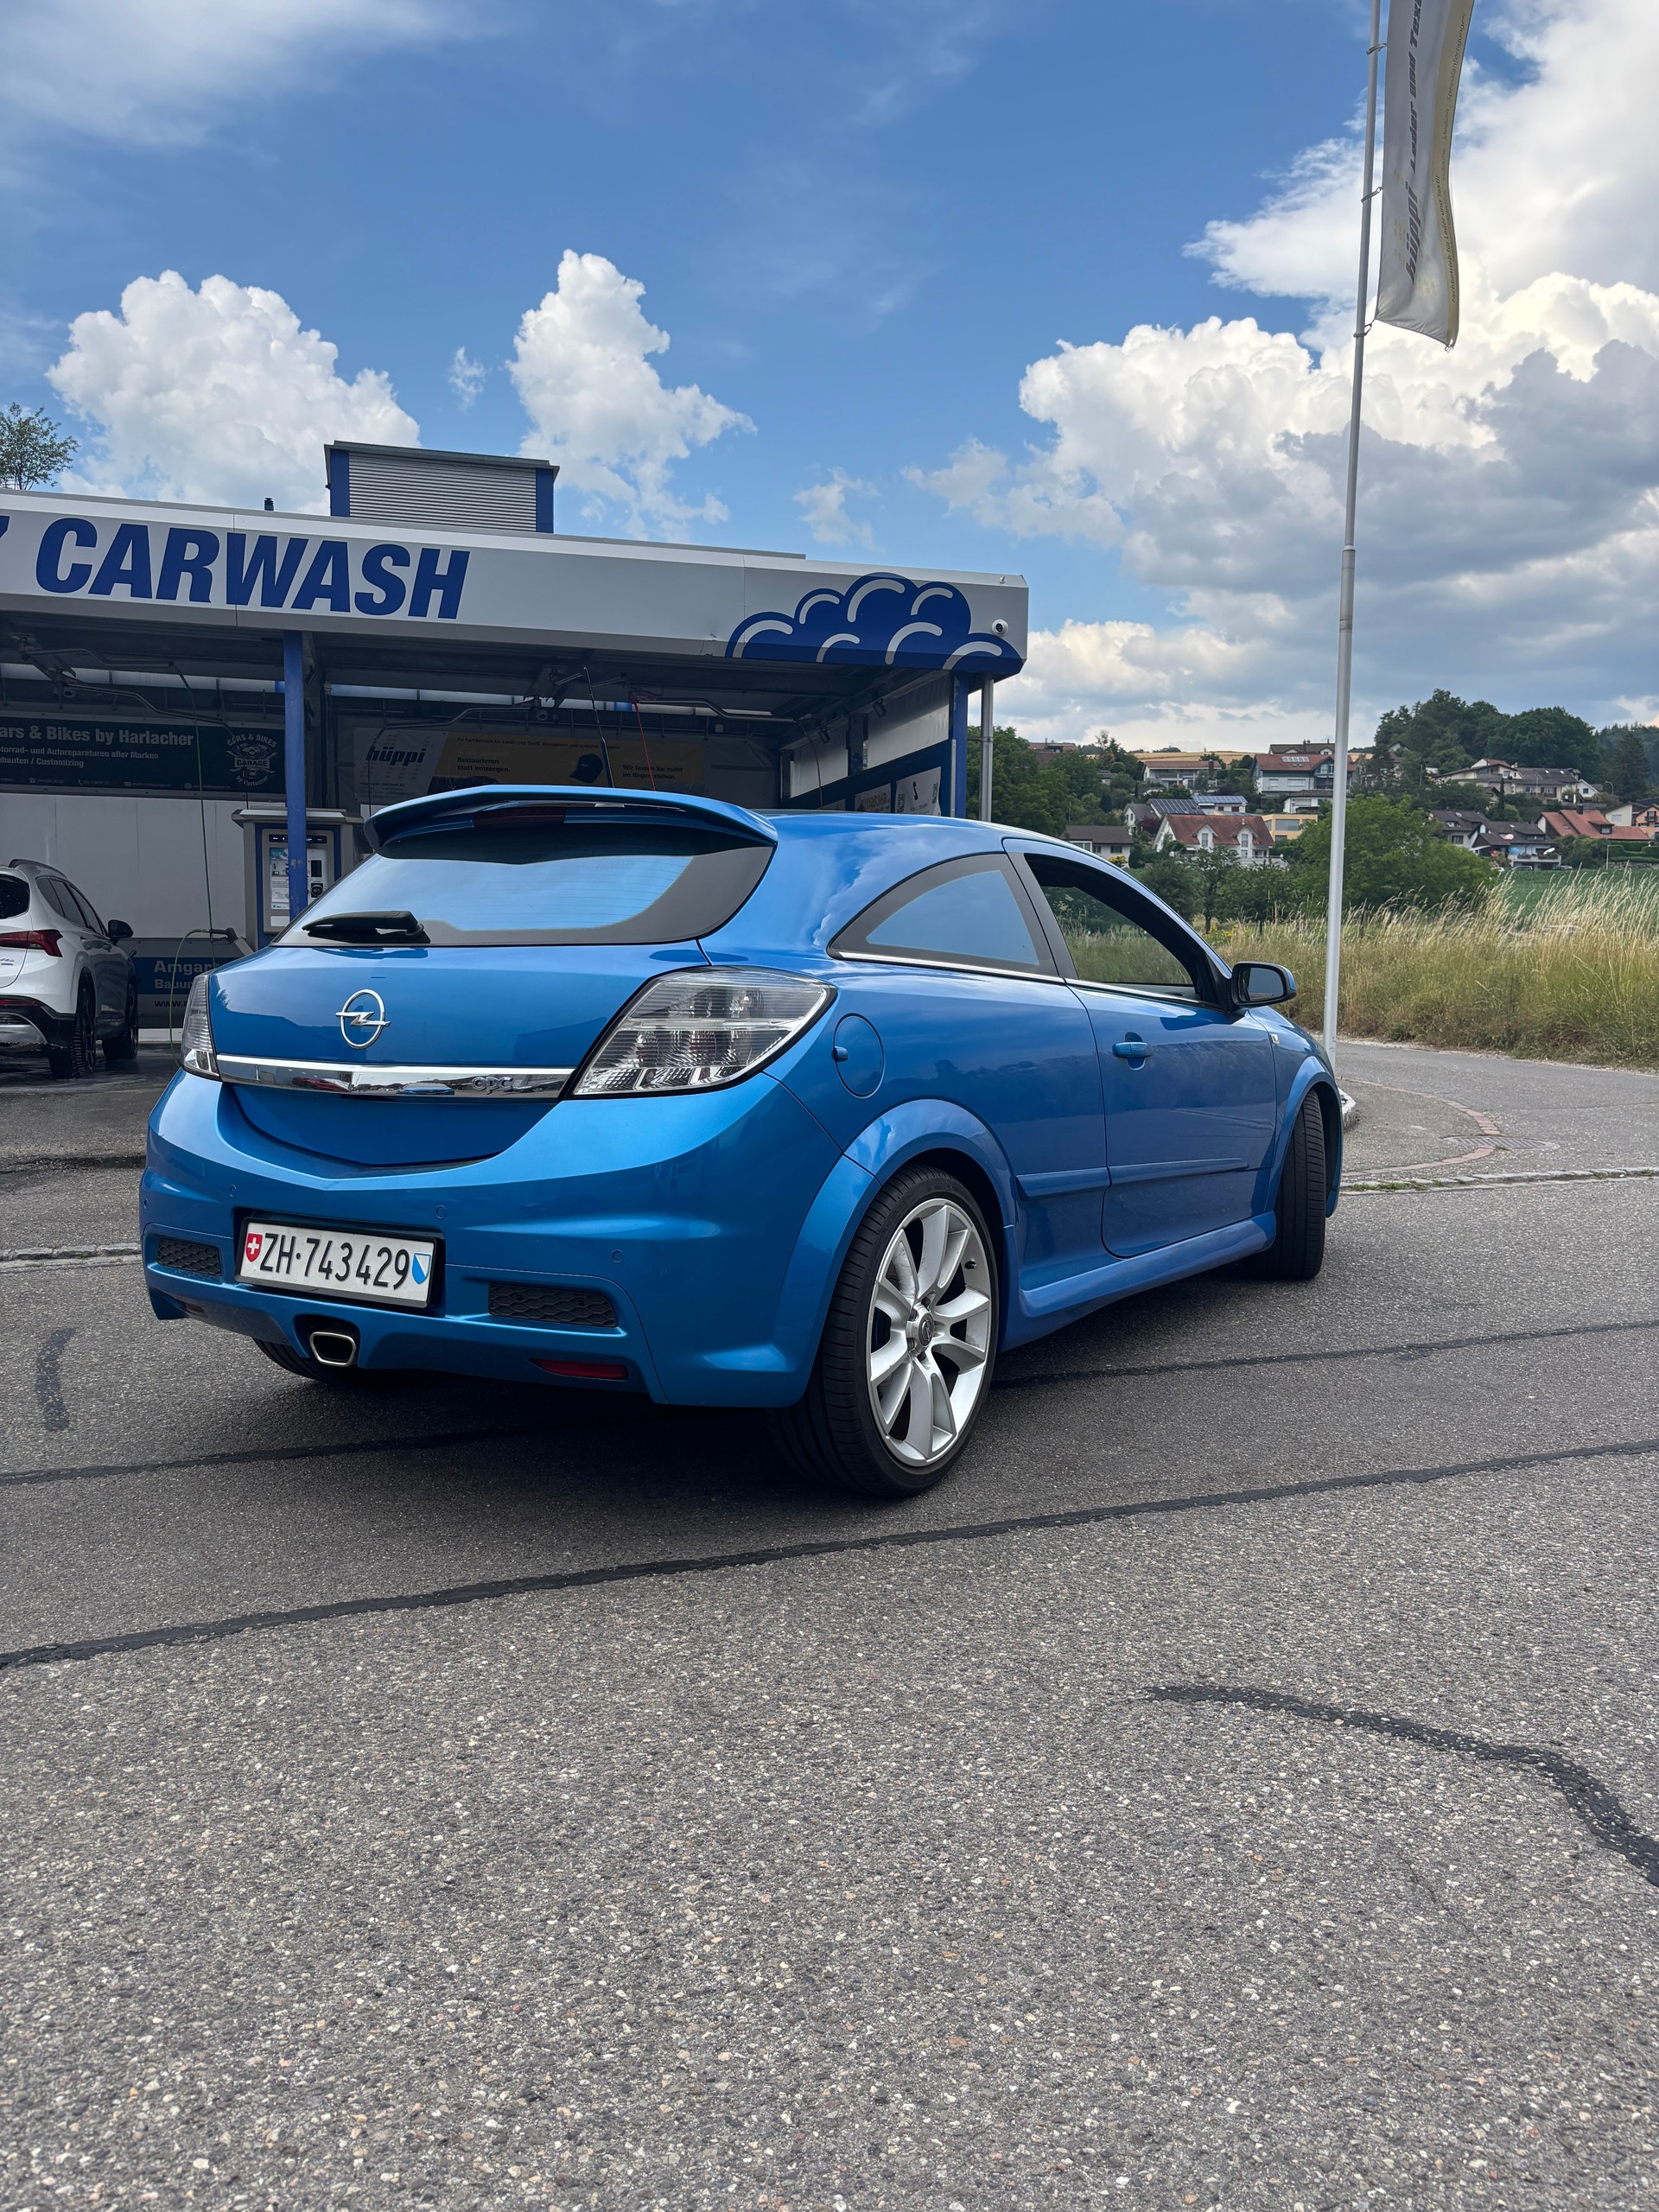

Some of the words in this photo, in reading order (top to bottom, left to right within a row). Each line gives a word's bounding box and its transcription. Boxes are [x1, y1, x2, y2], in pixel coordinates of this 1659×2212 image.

[1408, 52, 1417, 99] und
[1409, 101, 1418, 175] Leder
[1405, 181, 1421, 286] hüppi
[36, 518, 471, 620] CARWASH
[29, 725, 41, 739] &
[47, 726, 91, 741] Bikes
[95, 728, 113, 745] by
[119, 730, 194, 746] Harlacher
[226, 734, 246, 747] CARS
[256, 734, 276, 748] BIKES
[36, 758, 84, 768] Customizing
[47, 748, 110, 758] Autoreparaturen
[365, 746, 428, 766] hüppi
[457, 756, 499, 765] Restaurieren
[237, 760, 269, 768] GARAGE
